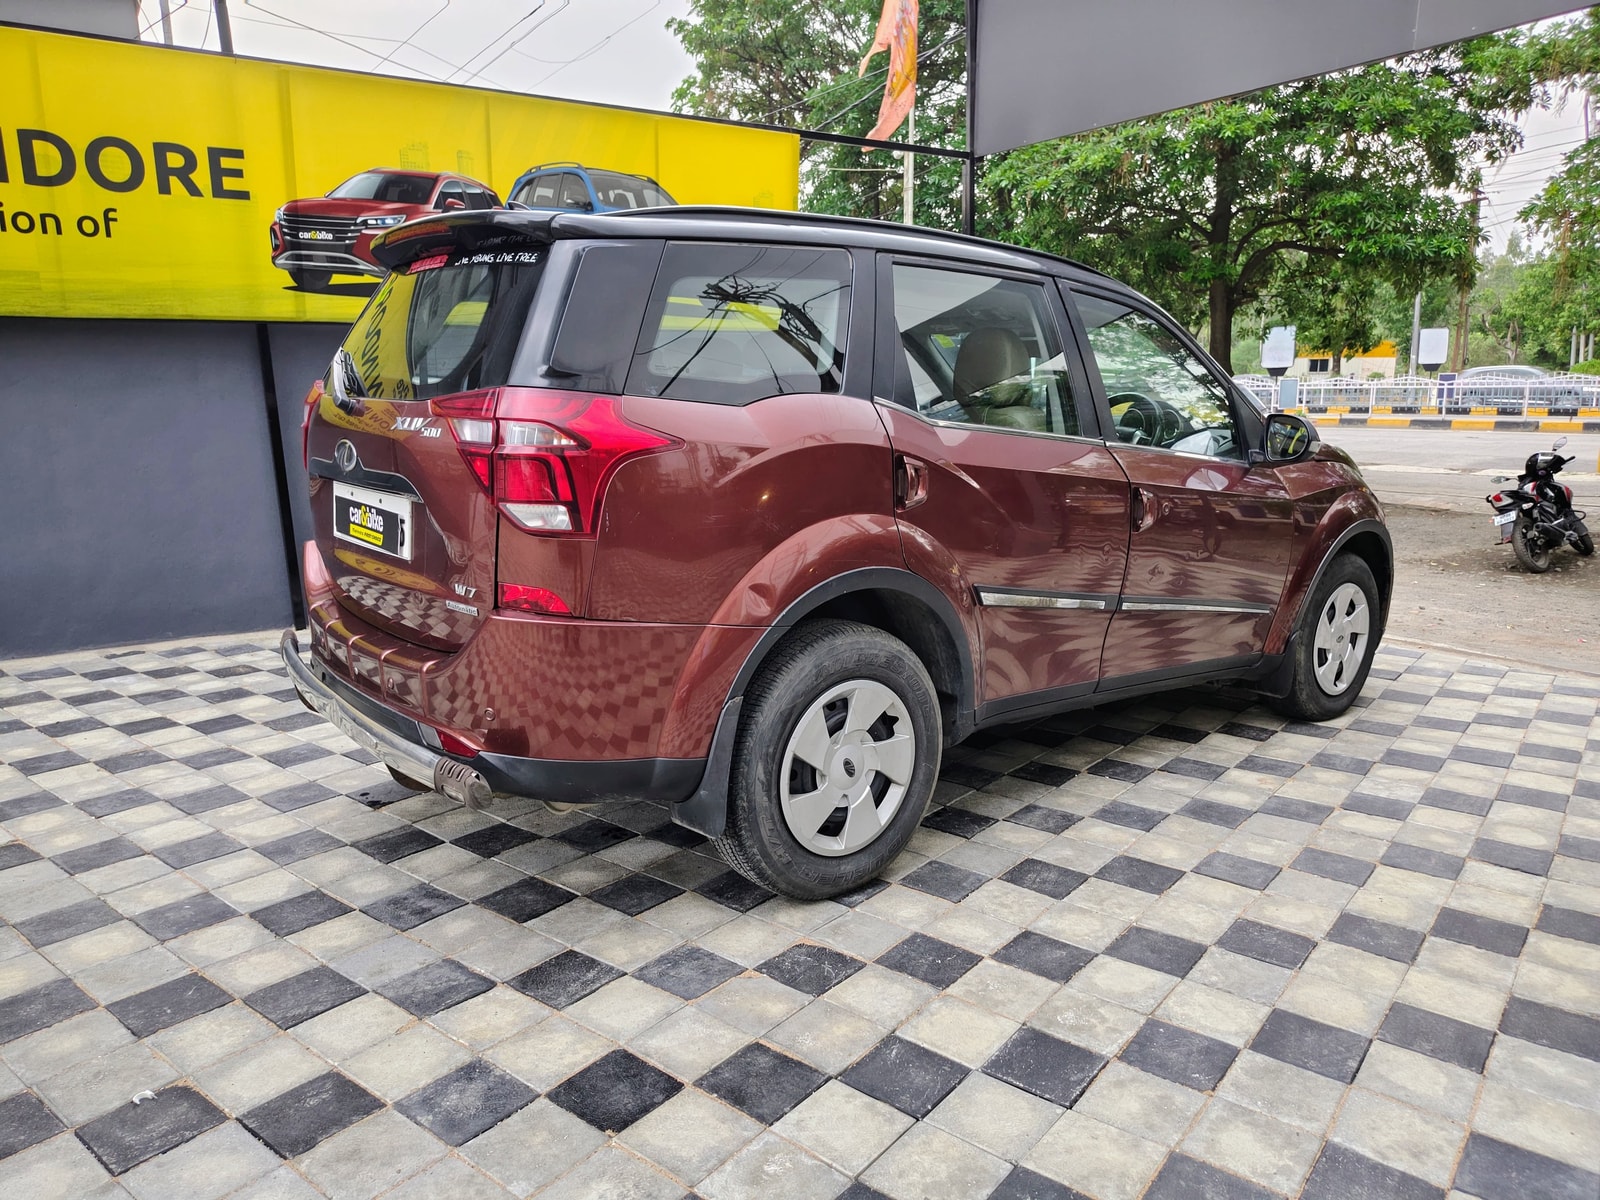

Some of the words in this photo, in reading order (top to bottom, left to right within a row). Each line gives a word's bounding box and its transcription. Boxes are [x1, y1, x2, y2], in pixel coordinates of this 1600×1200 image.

[76, 208, 118, 239] of
[298, 231, 334, 240] car&bike
[496, 252, 514, 262] LIVE
[515, 252, 538, 263] FREE
[349, 505, 384, 532] car&bike
[455, 583, 477, 598] W7
